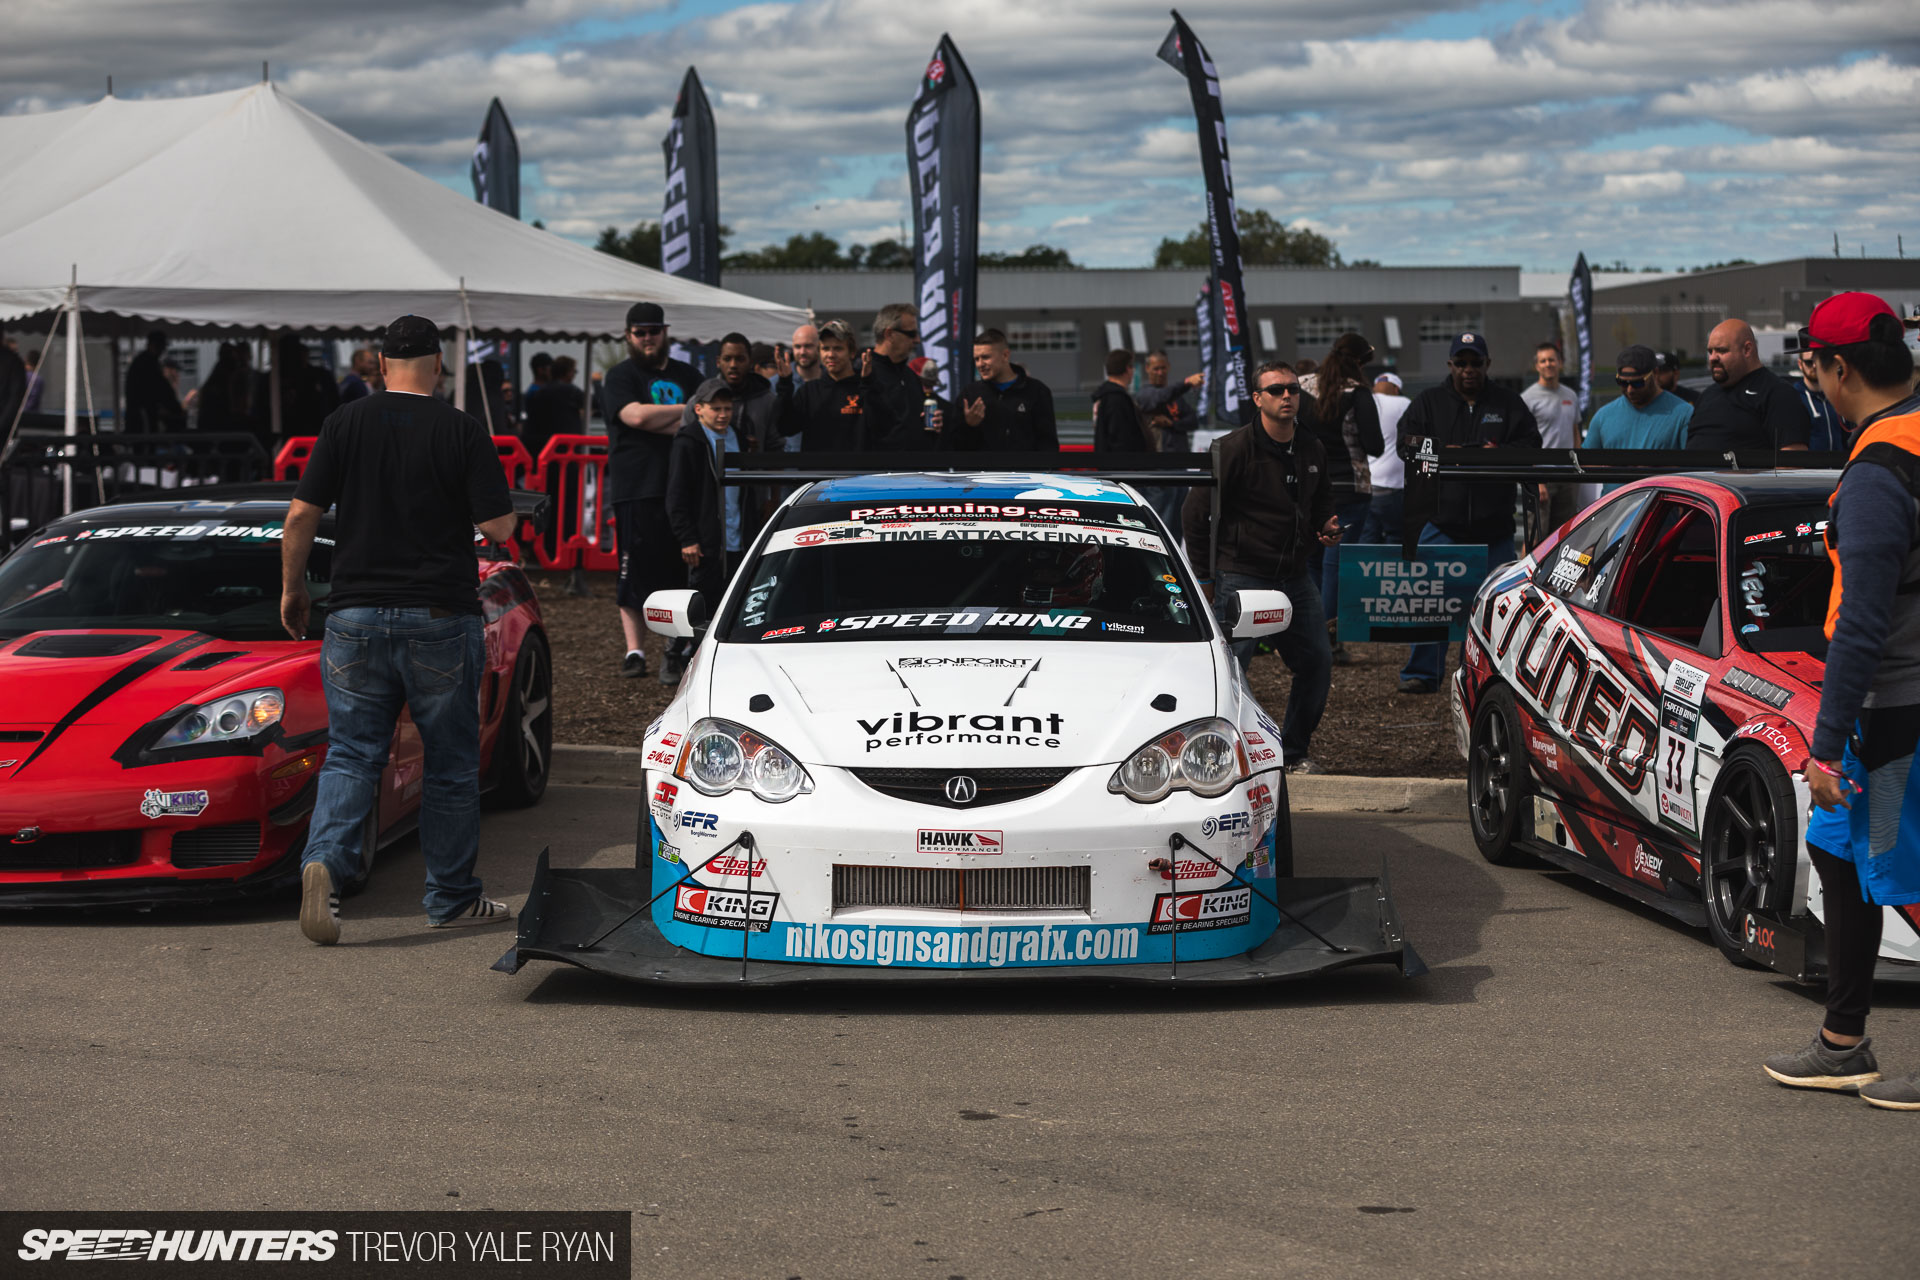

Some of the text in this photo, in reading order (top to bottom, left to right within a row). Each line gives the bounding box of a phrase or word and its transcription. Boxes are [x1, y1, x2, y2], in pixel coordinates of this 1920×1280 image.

[1233, 352, 1251, 401] vibrant
[851, 502, 1080, 521] pztuning.ca
[1029, 514, 1106, 525] Performance
[91, 525, 208, 541] SPEED
[875, 531, 938, 542] TIME
[943, 530, 1043, 541] ATTACK
[1044, 532, 1130, 547] FINALS
[1358, 561, 1467, 577] YIELD TO
[1380, 580, 1445, 595] RACE
[647, 609, 673, 620] MOTUL
[1360, 597, 1462, 614] TRAFFIC
[836, 612, 1092, 632] SPEED RING
[1254, 610, 1284, 620] MOTUL
[1368, 615, 1453, 623] BECAUSE RACECAR
[761, 625, 806, 639] ARP
[1106, 622, 1145, 632] vibrant
[923, 657, 1032, 665] ONPOINT
[1666, 701, 1697, 722] SPEED RING
[857, 711, 1064, 736] vibrant
[866, 733, 1061, 752] performance
[1532, 736, 1557, 755] Honeywell
[1762, 726, 1792, 756] TECH
[1665, 736, 1686, 795] 33
[156, 792, 207, 807] VIKING
[681, 811, 719, 831] EFR
[1219, 811, 1250, 832] EFR
[690, 830, 718, 838] BorgWarner
[920, 832, 974, 847] HAWK
[1640, 852, 1663, 872] EXEDY
[707, 896, 770, 915] KING
[1203, 893, 1249, 914] KING
[674, 910, 768, 929] ENGINE BEARING SPECIAISTS
[1182, 921, 1214, 930] BEARING
[1215, 914, 1249, 927] SPECIALISTS
[785, 923, 1139, 967] nikosignsandgrafx.com
